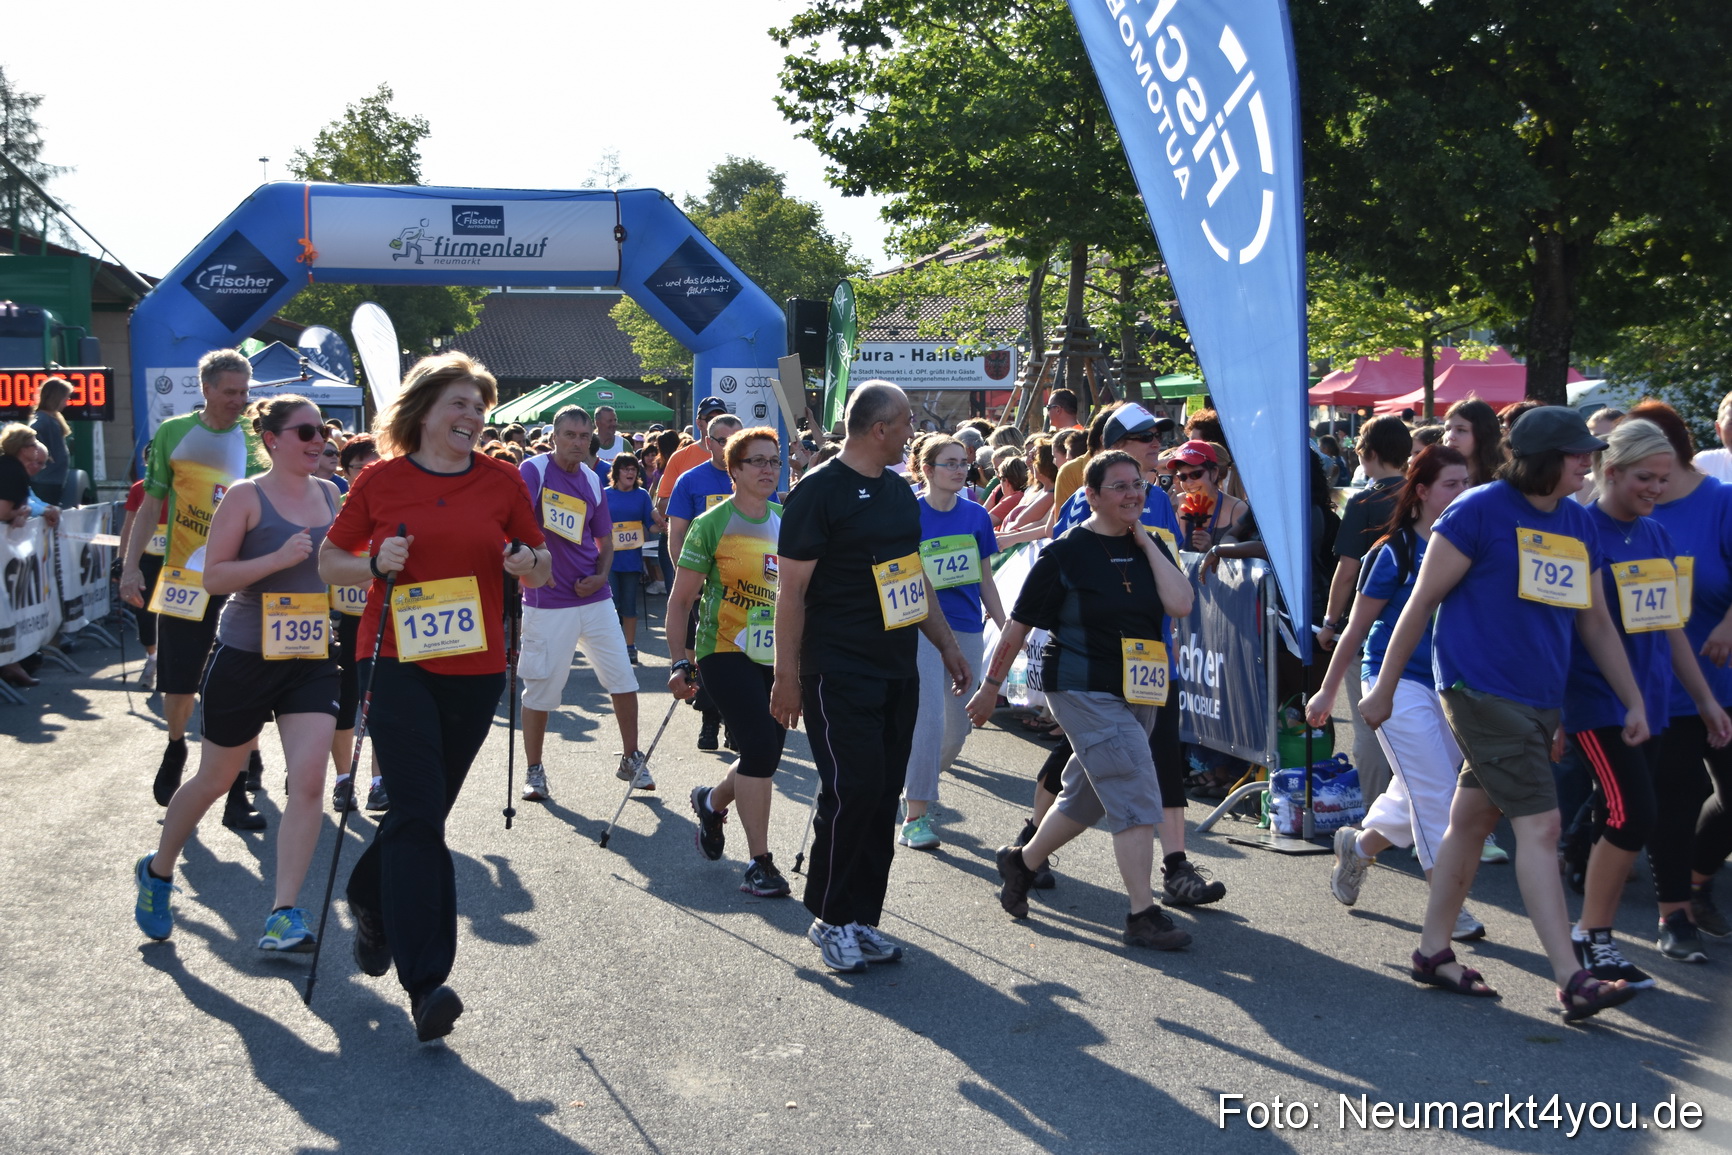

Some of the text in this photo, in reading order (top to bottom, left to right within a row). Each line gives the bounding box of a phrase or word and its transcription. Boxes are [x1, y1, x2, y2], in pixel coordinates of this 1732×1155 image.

[464, 217, 501, 225] Fischer
[434, 236, 549, 257] firmenlauf
[210, 275, 274, 287] Fischer
[665, 278, 682, 287] und
[683, 276, 699, 285] das
[550, 508, 575, 529] 310
[618, 532, 638, 543] 804
[933, 554, 969, 575] 742
[1531, 558, 1574, 588] 792
[165, 587, 200, 606] 997
[887, 578, 925, 609] 1184
[1631, 587, 1667, 612] 747
[271, 620, 323, 641] 1395
[404, 607, 475, 639] 1378
[1176, 633, 1224, 688] cher
[1130, 664, 1165, 688] 1243
[1179, 690, 1221, 720] OMOBILE
